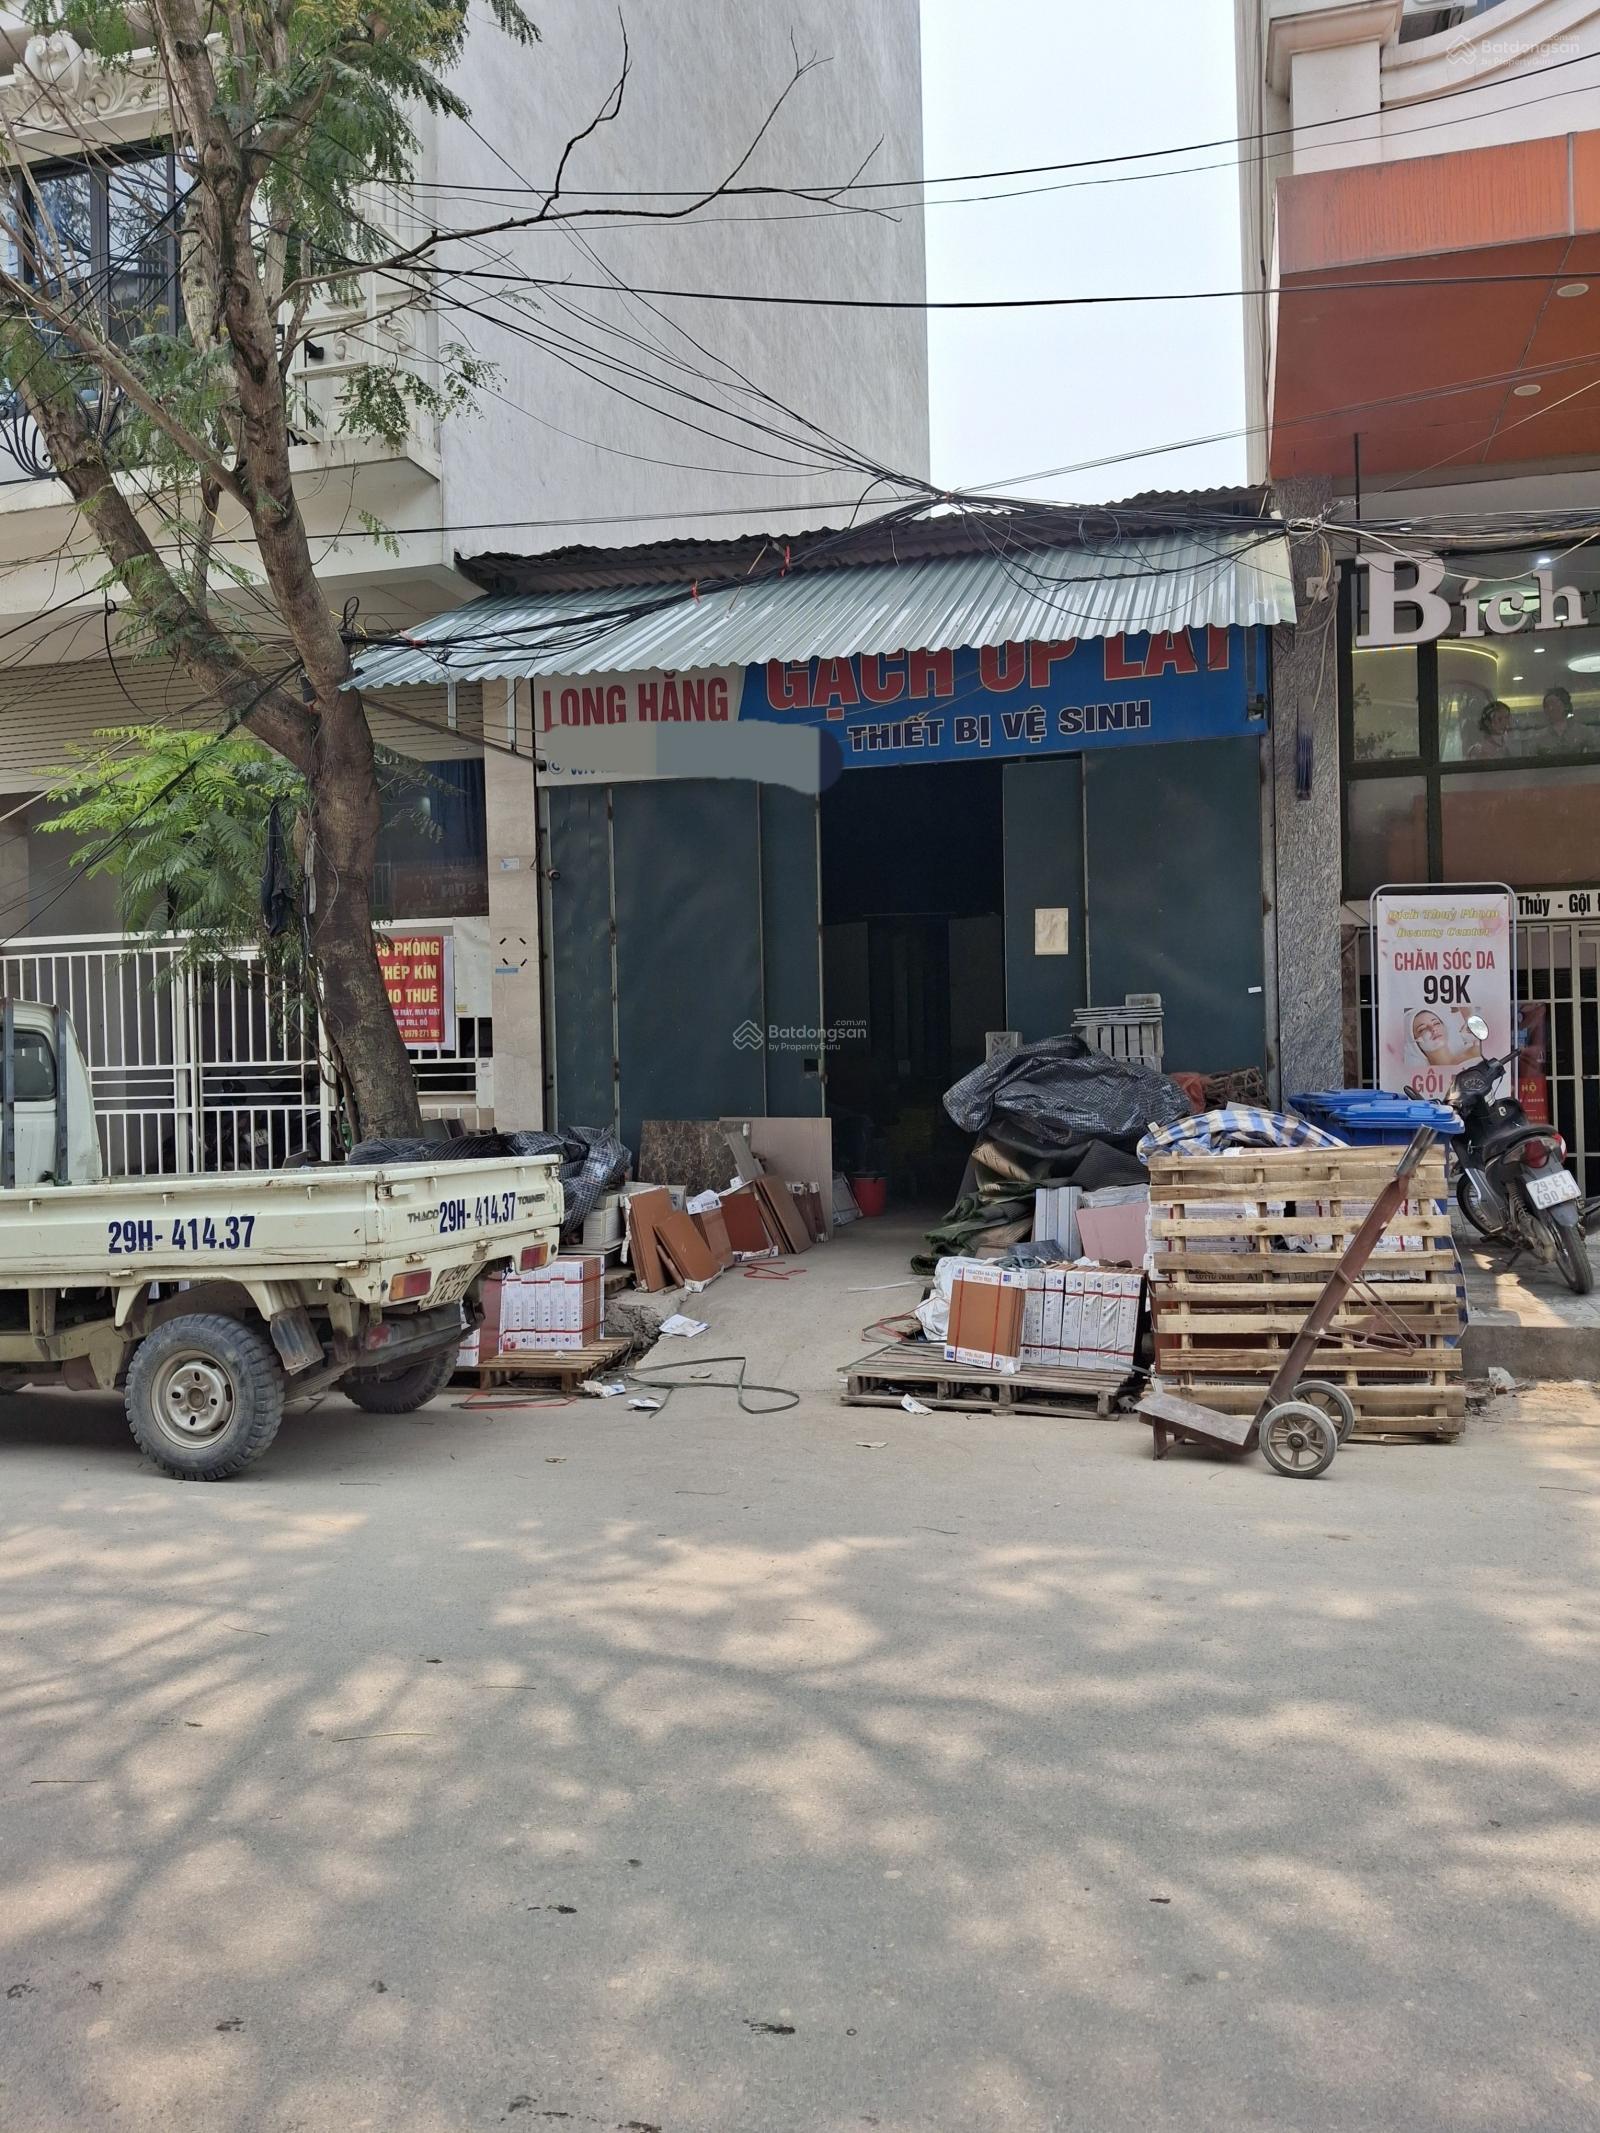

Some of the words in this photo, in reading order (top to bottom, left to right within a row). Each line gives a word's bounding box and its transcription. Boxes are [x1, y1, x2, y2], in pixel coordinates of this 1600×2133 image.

[767, 648, 954, 721] GẠCH
[954, 714, 991, 748] BỊ
[1001, 704, 1047, 743] VỆ
[1058, 700, 1151, 735] SINH
[1517, 893, 1550, 917] Thủy
[381, 962, 411, 980] HÉP
[414, 962, 437, 980] KÍN
[1394, 949, 1438, 971] CHĂM
[1443, 948, 1472, 970] SÓC
[1476, 951, 1495, 970] DA
[405, 985, 438, 1003] THUÊ
[1423, 975, 1471, 1004] 99K
[1412, 1068, 1444, 1098] GỘI
[440, 1198, 471, 1234] 29H-
[474, 1191, 516, 1227] 414.37
[108, 1220, 163, 1254] 29H-
[171, 1215, 256, 1251] 414.37
